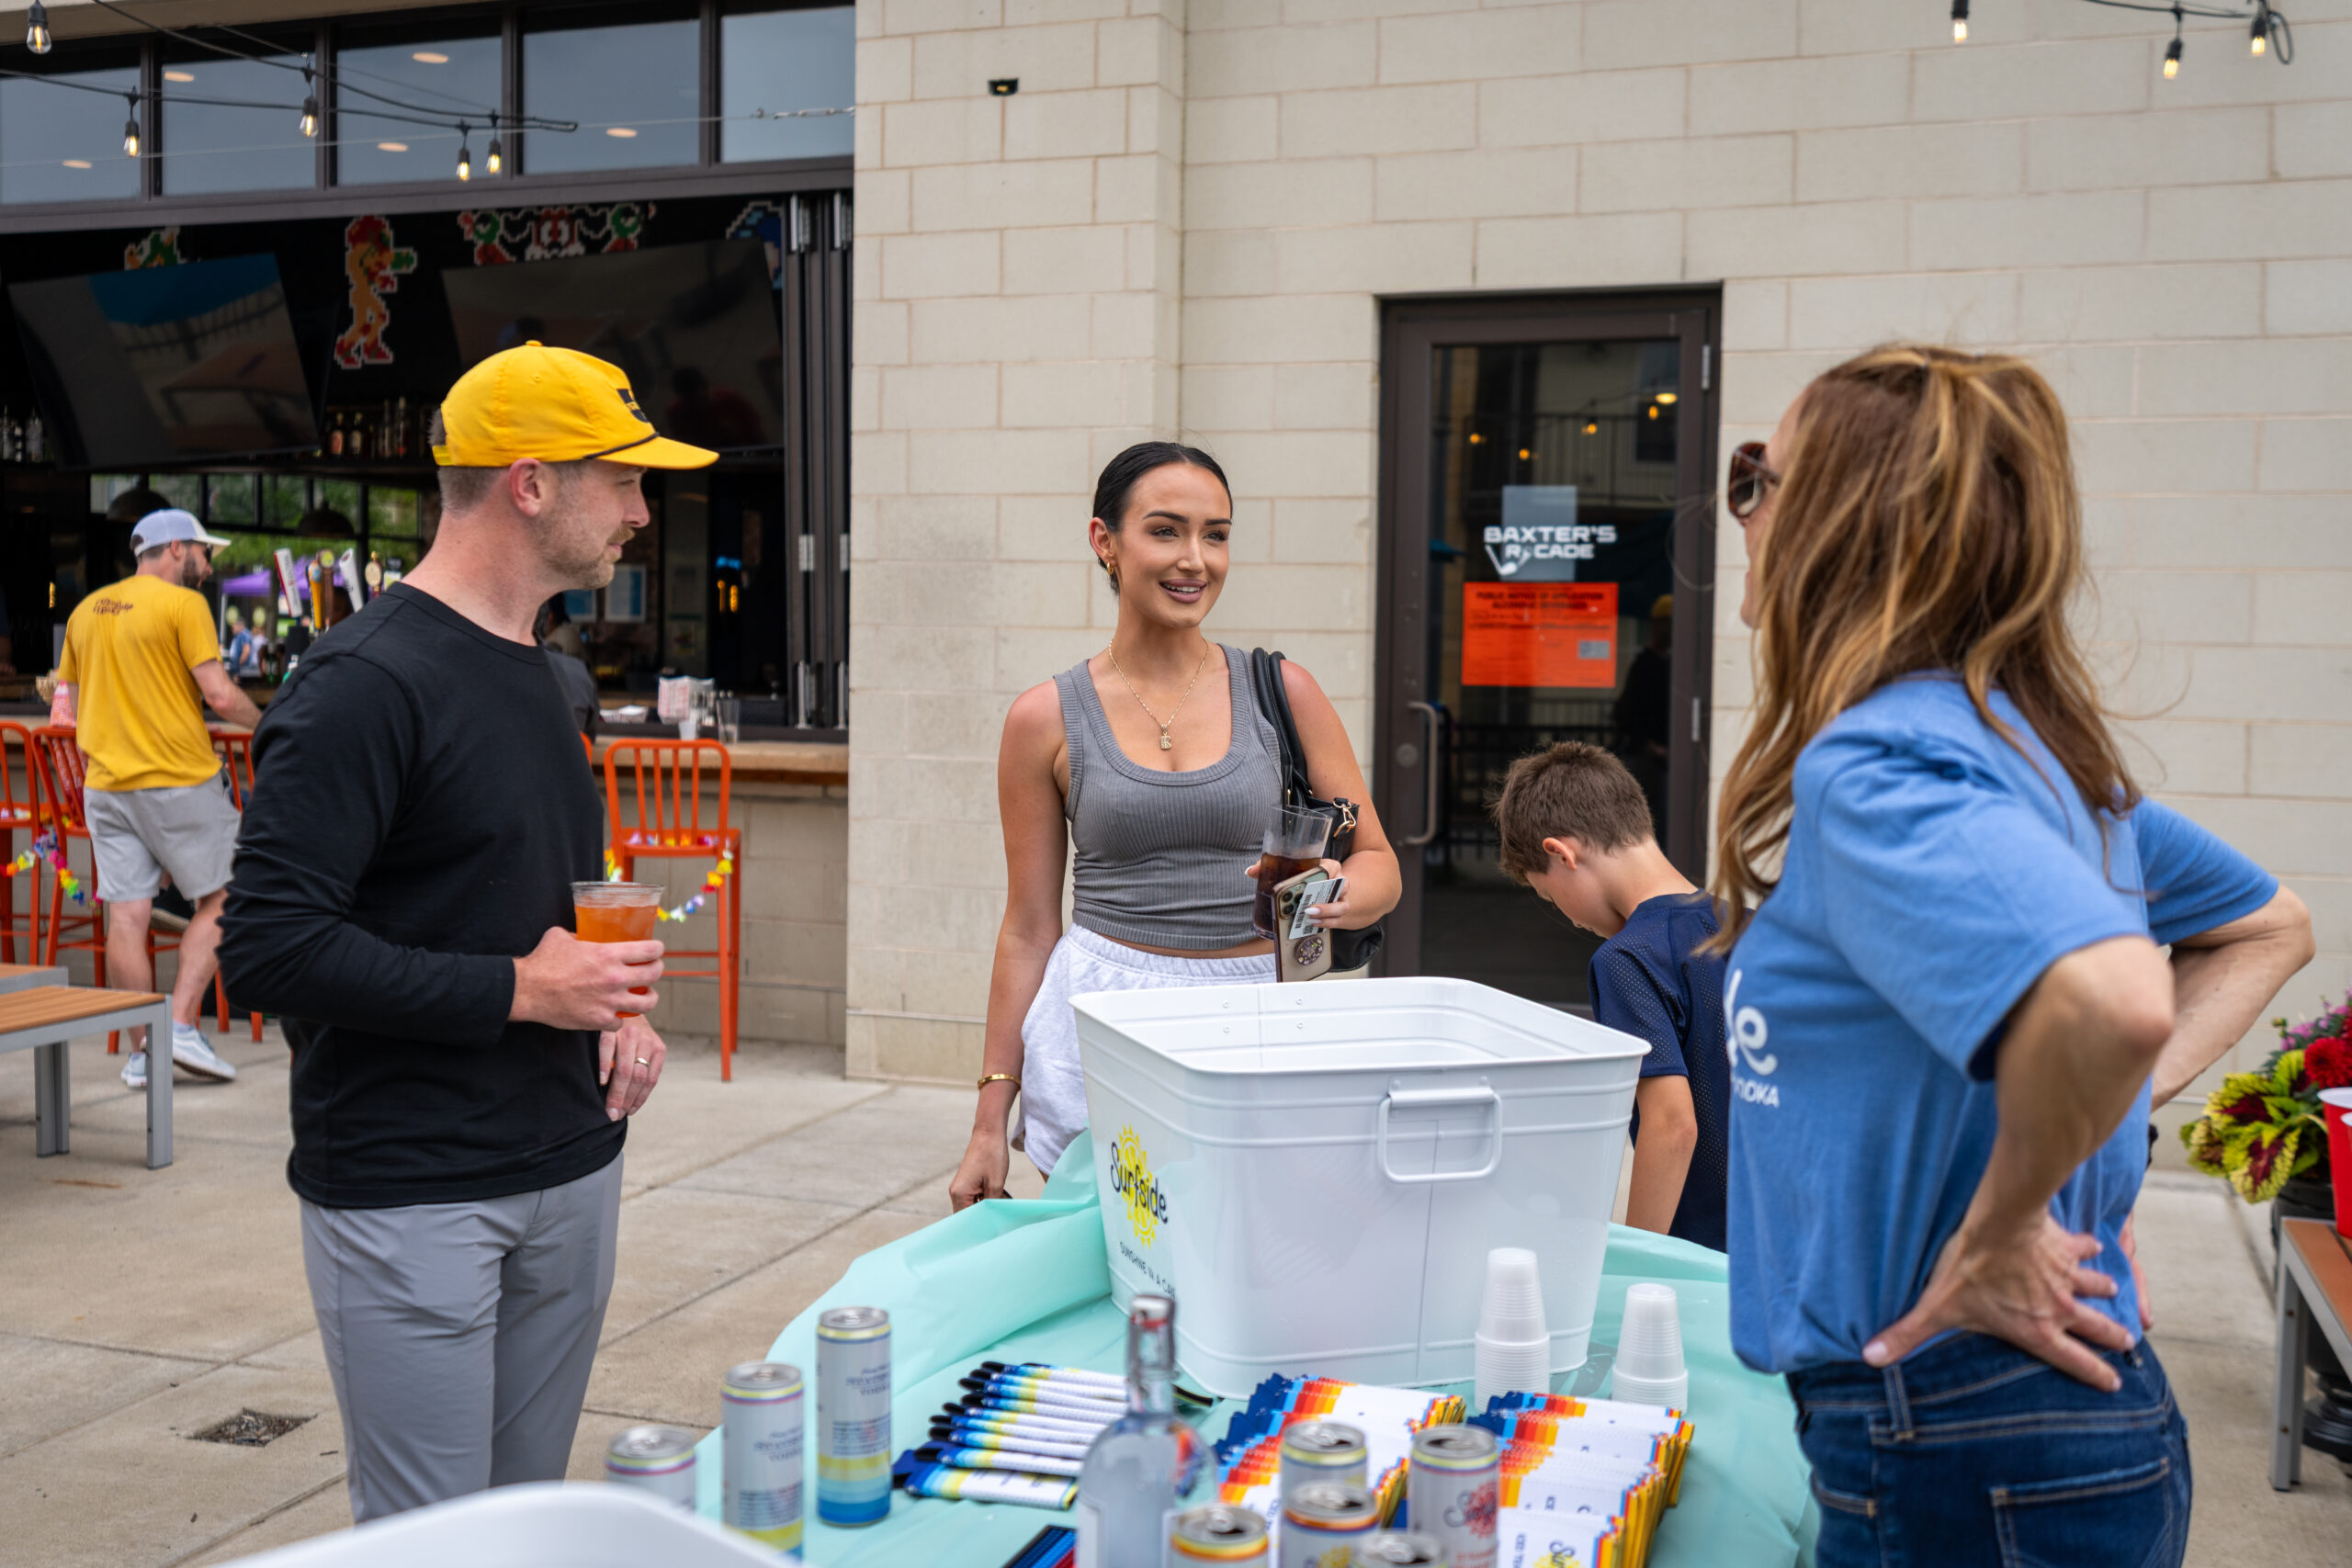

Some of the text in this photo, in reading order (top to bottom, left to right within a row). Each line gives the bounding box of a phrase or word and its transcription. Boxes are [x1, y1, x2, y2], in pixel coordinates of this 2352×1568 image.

[1484, 525, 1617, 543] BAXTER'S
[1110, 1142, 1168, 1224] Surfside
[1119, 1241, 1148, 1275] SUNSHINE
[1162, 1279, 1176, 1300] CAN
